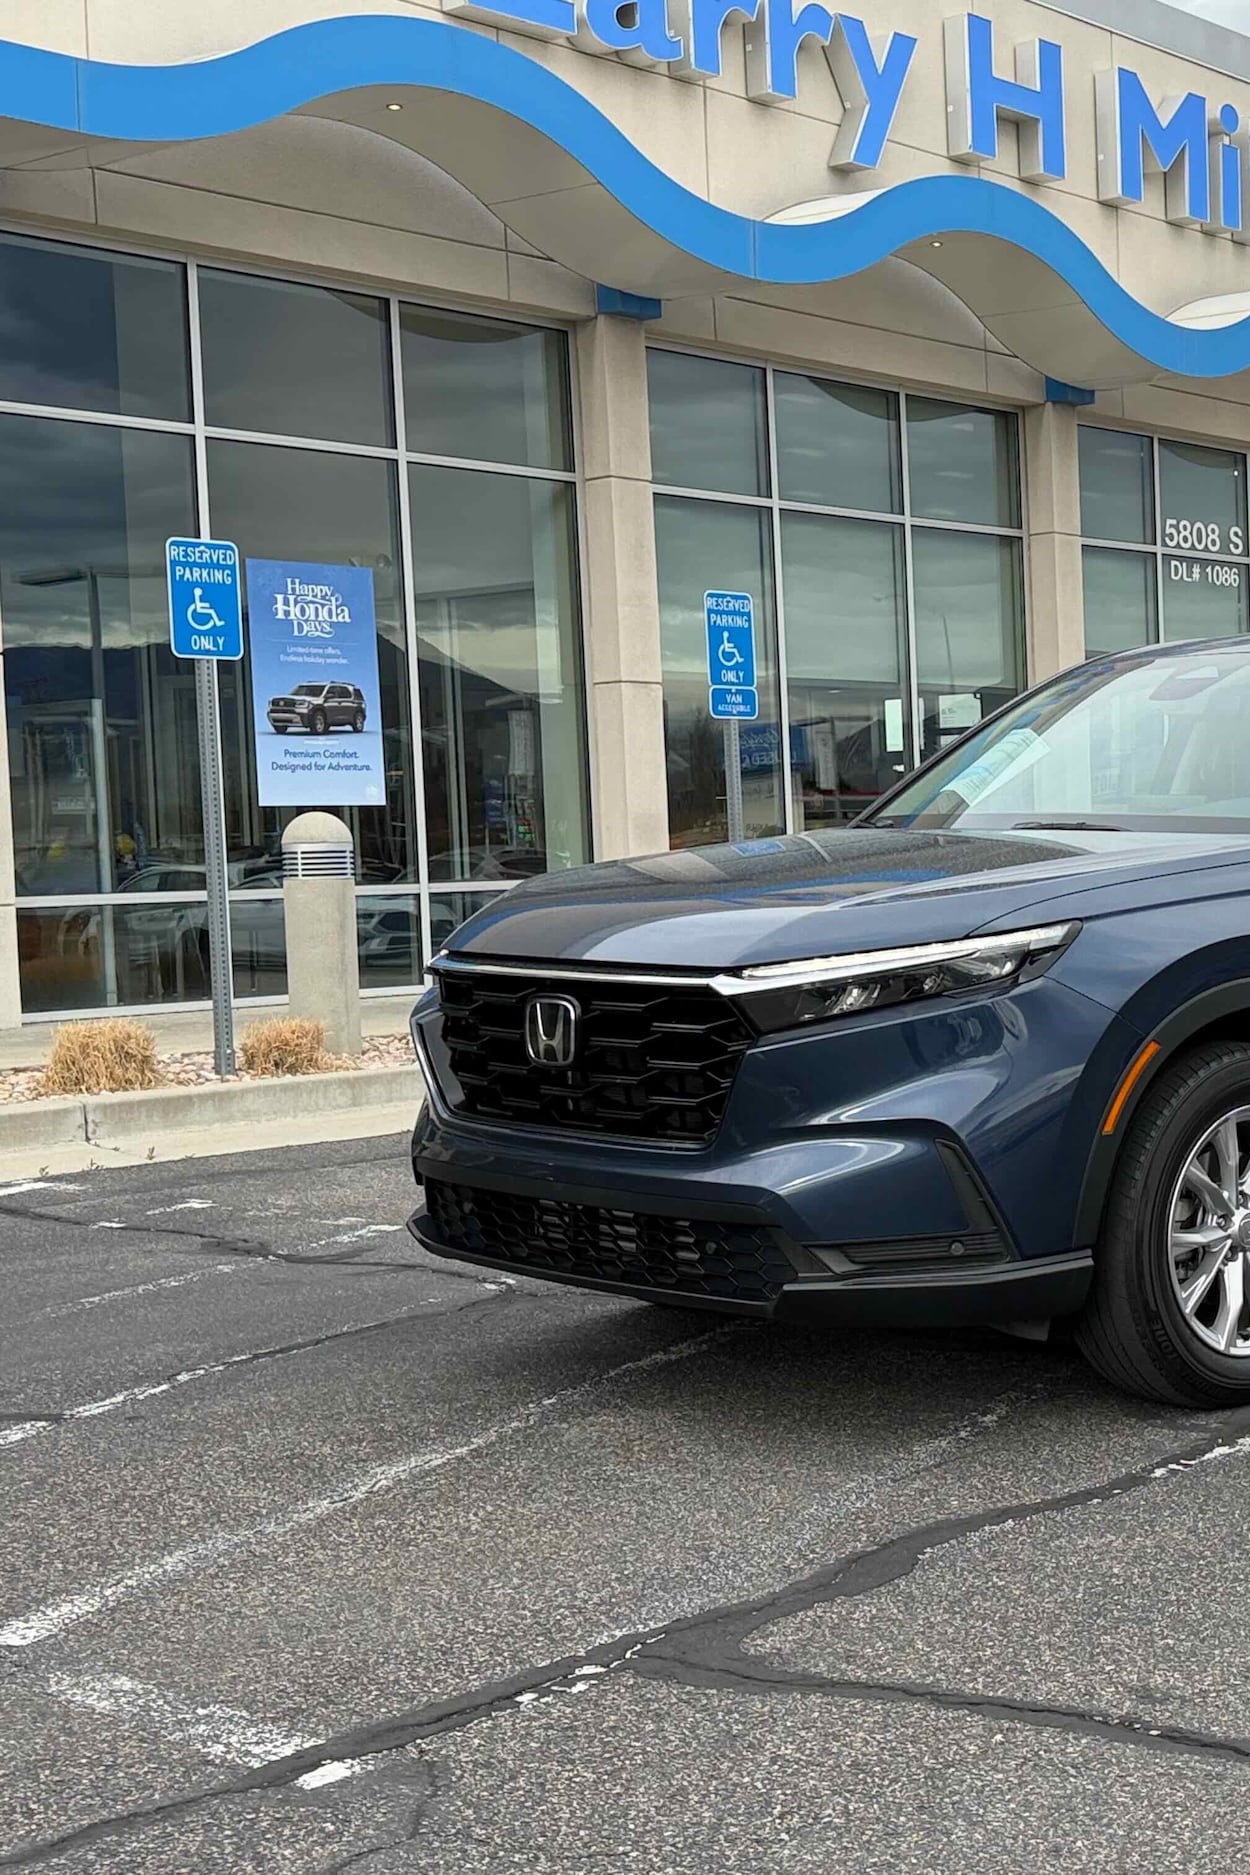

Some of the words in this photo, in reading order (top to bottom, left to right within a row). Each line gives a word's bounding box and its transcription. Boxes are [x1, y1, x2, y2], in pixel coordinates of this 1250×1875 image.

[966, 12, 1065, 181] H
[1164, 518, 1221, 552] 5808
[1229, 526, 1244, 555] S
[170, 545, 235, 565] RESERVED
[175, 565, 232, 585] PARKING
[1170, 560, 1201, 582] DL#
[1205, 565, 1240, 588] 1086
[286, 578, 341, 604] Happy
[272, 594, 351, 623] Honda
[707, 597, 751, 612] RESERVED
[293, 620, 335, 638] Days
[710, 614, 749, 628] PARKING
[191, 634, 225, 652] ONLY
[721, 670, 745, 683] ONLY
[726, 693, 743, 703] VAN
[284, 749, 321, 758] Premium
[271, 762, 313, 773] Designed
[313, 762, 325, 771] for
